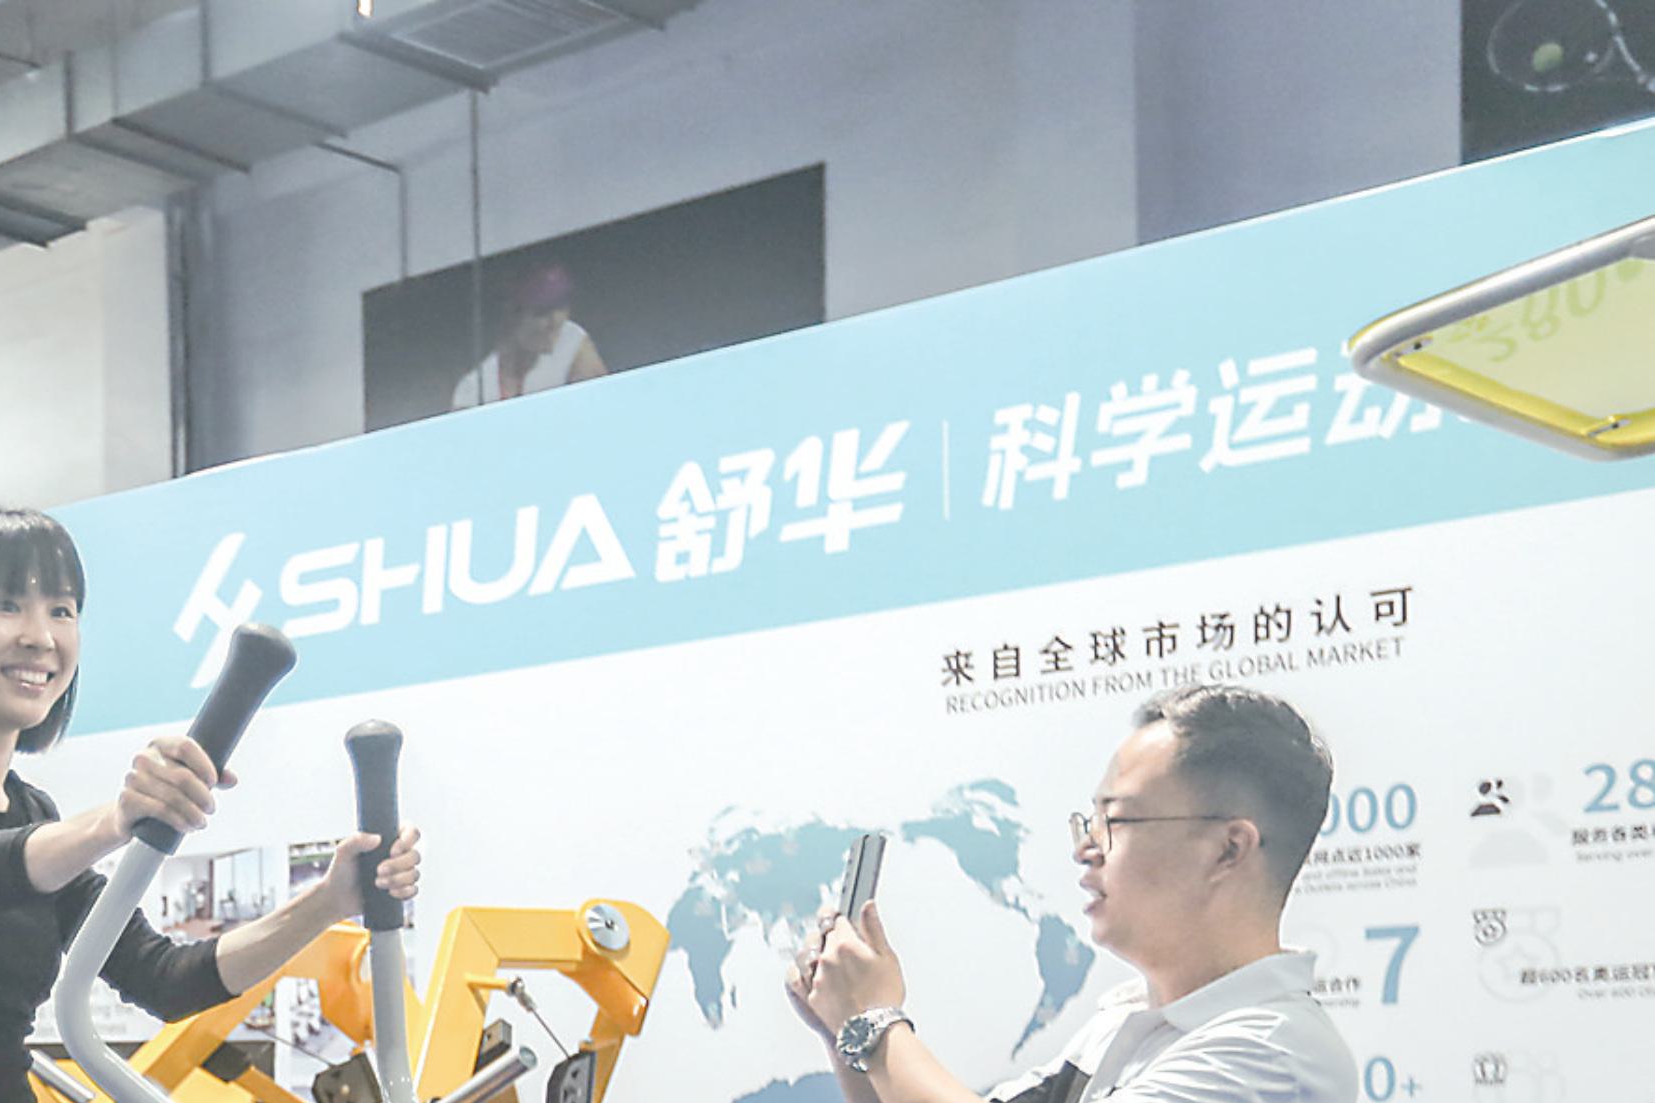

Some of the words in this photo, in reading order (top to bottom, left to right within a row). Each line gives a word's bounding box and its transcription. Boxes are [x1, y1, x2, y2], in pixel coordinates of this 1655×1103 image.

[279, 492, 636, 640] SHUA
[655, 420, 910, 582] 舒华
[941, 585, 1415, 688] 来自全球市场的认可
[945, 678, 1086, 714] RECOGNITION
[1092, 671, 1153, 698] FROM
[1160, 663, 1203, 687] THE
[1208, 650, 1299, 681] GLOBAL
[1306, 635, 1406, 668] MARKET
[1583, 758, 1655, 814] 28
[1365, 925, 1420, 1005] 7
